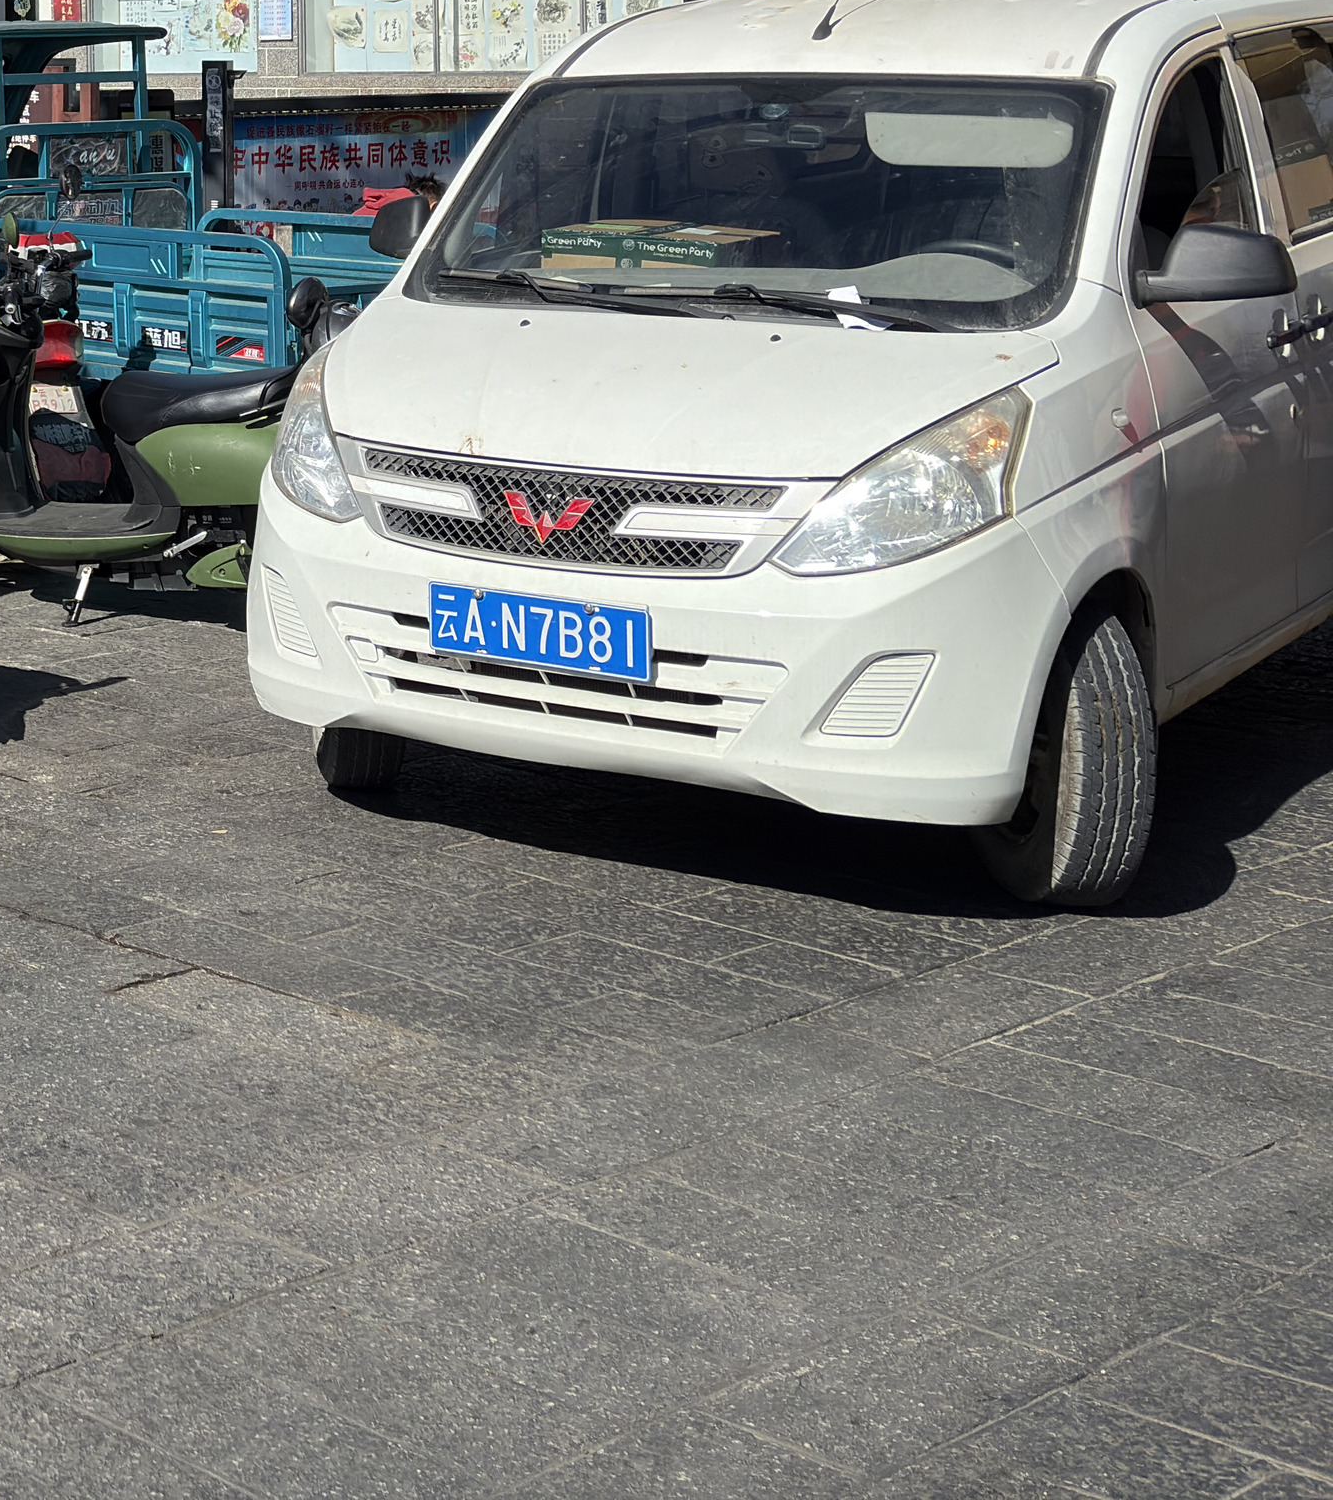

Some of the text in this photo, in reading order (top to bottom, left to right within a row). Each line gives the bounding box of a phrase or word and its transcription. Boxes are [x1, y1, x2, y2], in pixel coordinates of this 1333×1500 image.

[547, 236, 603, 249] Green Party
[637, 241, 714, 260] The Green Party
[145, 327, 182, 349] 蓝旭
